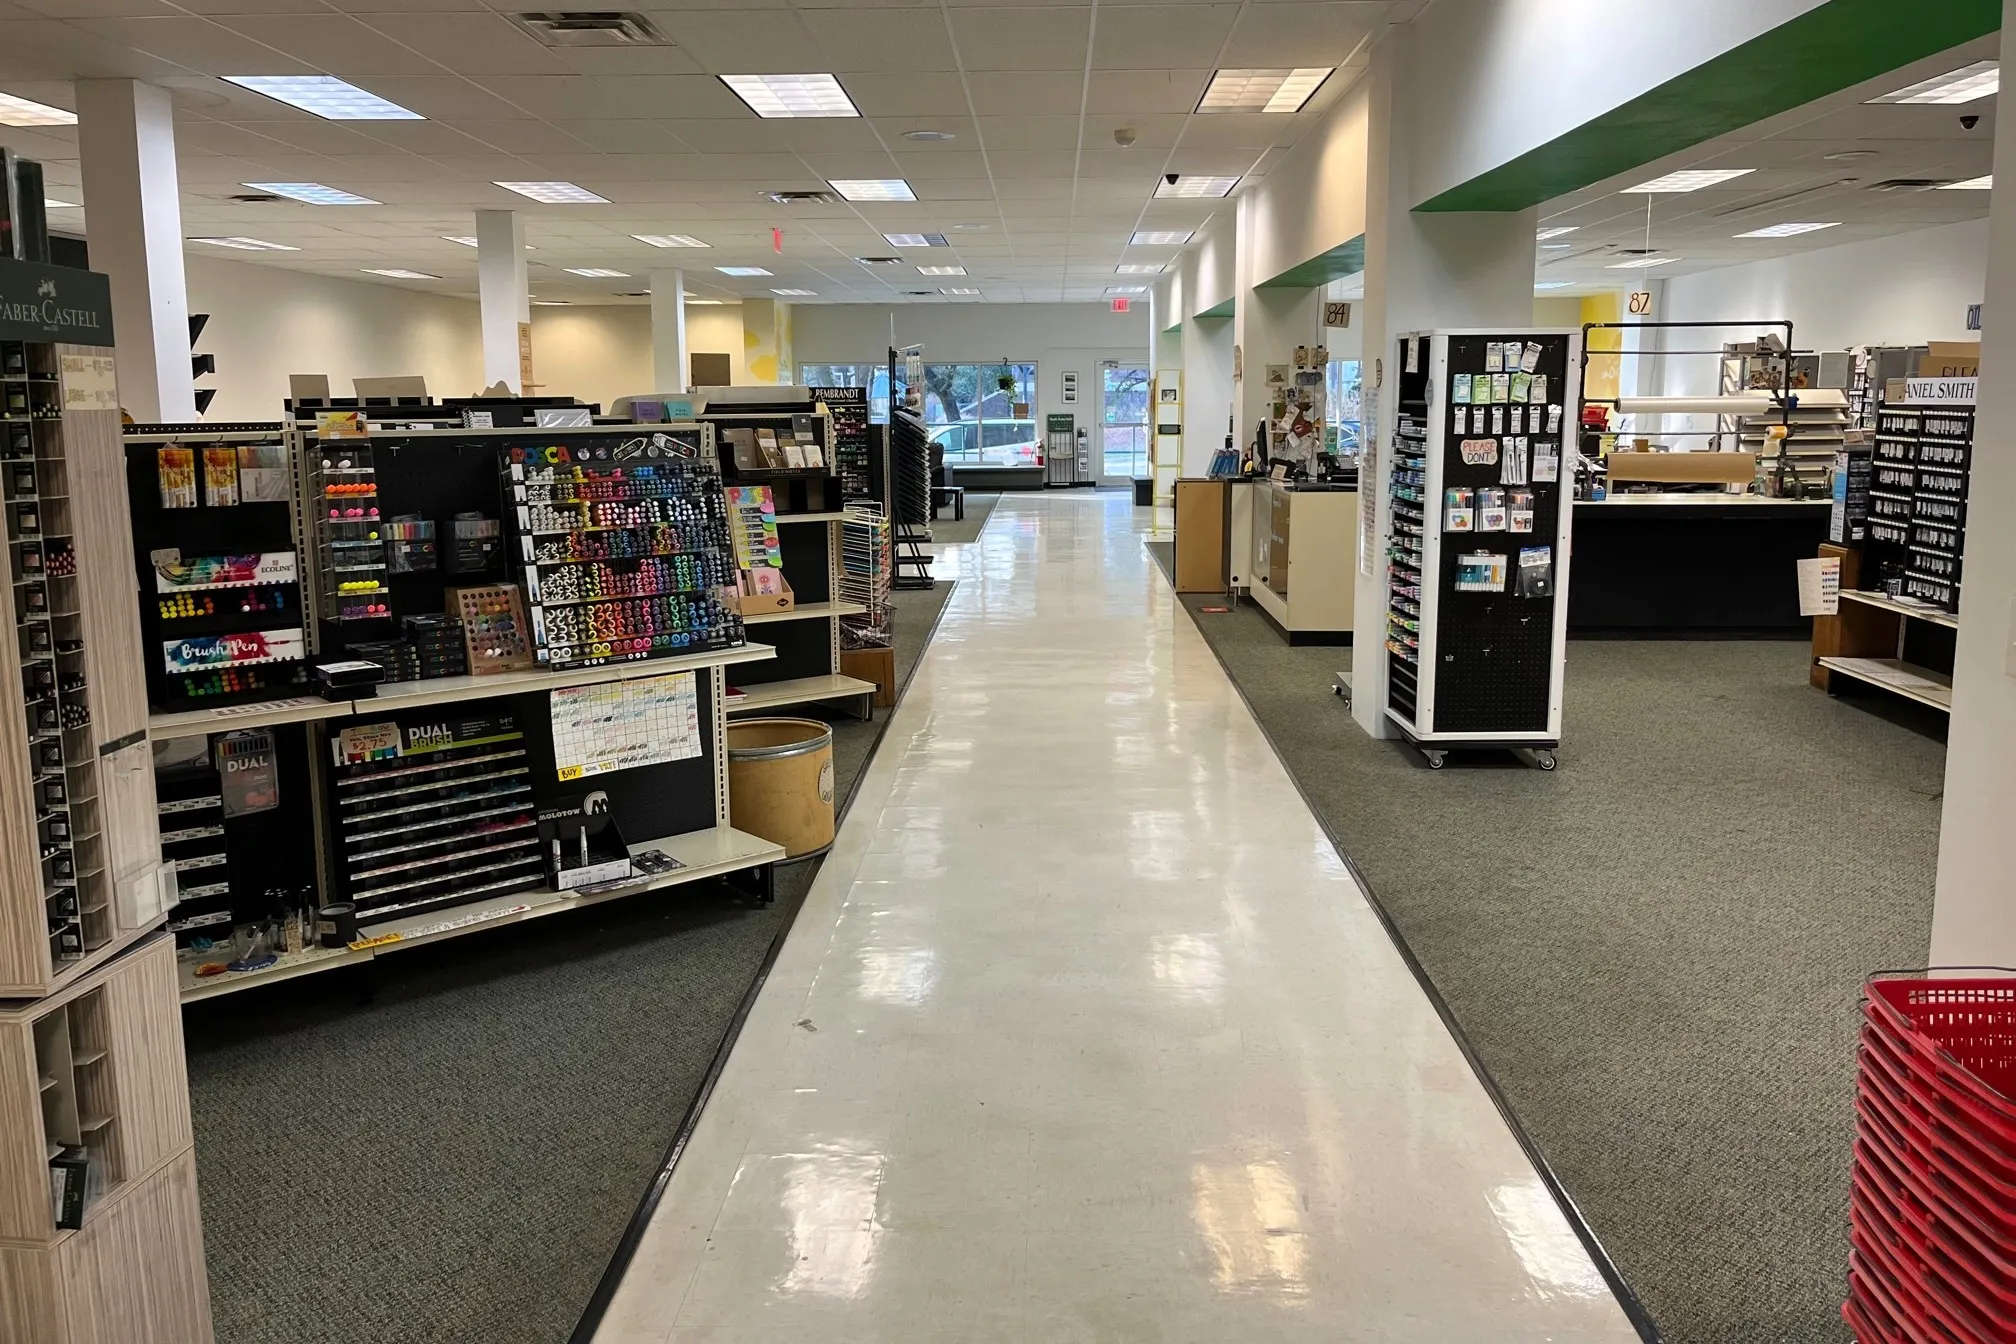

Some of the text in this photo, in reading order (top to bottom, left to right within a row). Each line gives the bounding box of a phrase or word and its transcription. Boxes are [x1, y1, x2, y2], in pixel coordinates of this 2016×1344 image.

[1113, 299, 1128, 311] EXIT
[1629, 293, 1650, 313] 87
[1327, 304, 1346, 325] 84
[815, 388, 859, 398] REMBRANDT
[1906, 382, 1975, 398] ANIEL SMITH
[1463, 441, 1495, 452] PLEASE
[511, 446, 572, 464] POSCA
[261, 564, 291, 574] ECOLINE
[181, 639, 258, 659] Brush Pen
[408, 724, 452, 740] DUAL
[352, 737, 387, 750] $2.75
[411, 733, 453, 748] BRUSH
[227, 756, 268, 772] DUAL
[561, 768, 577, 779] BUY
[538, 808, 581, 820] MOLOTOW
